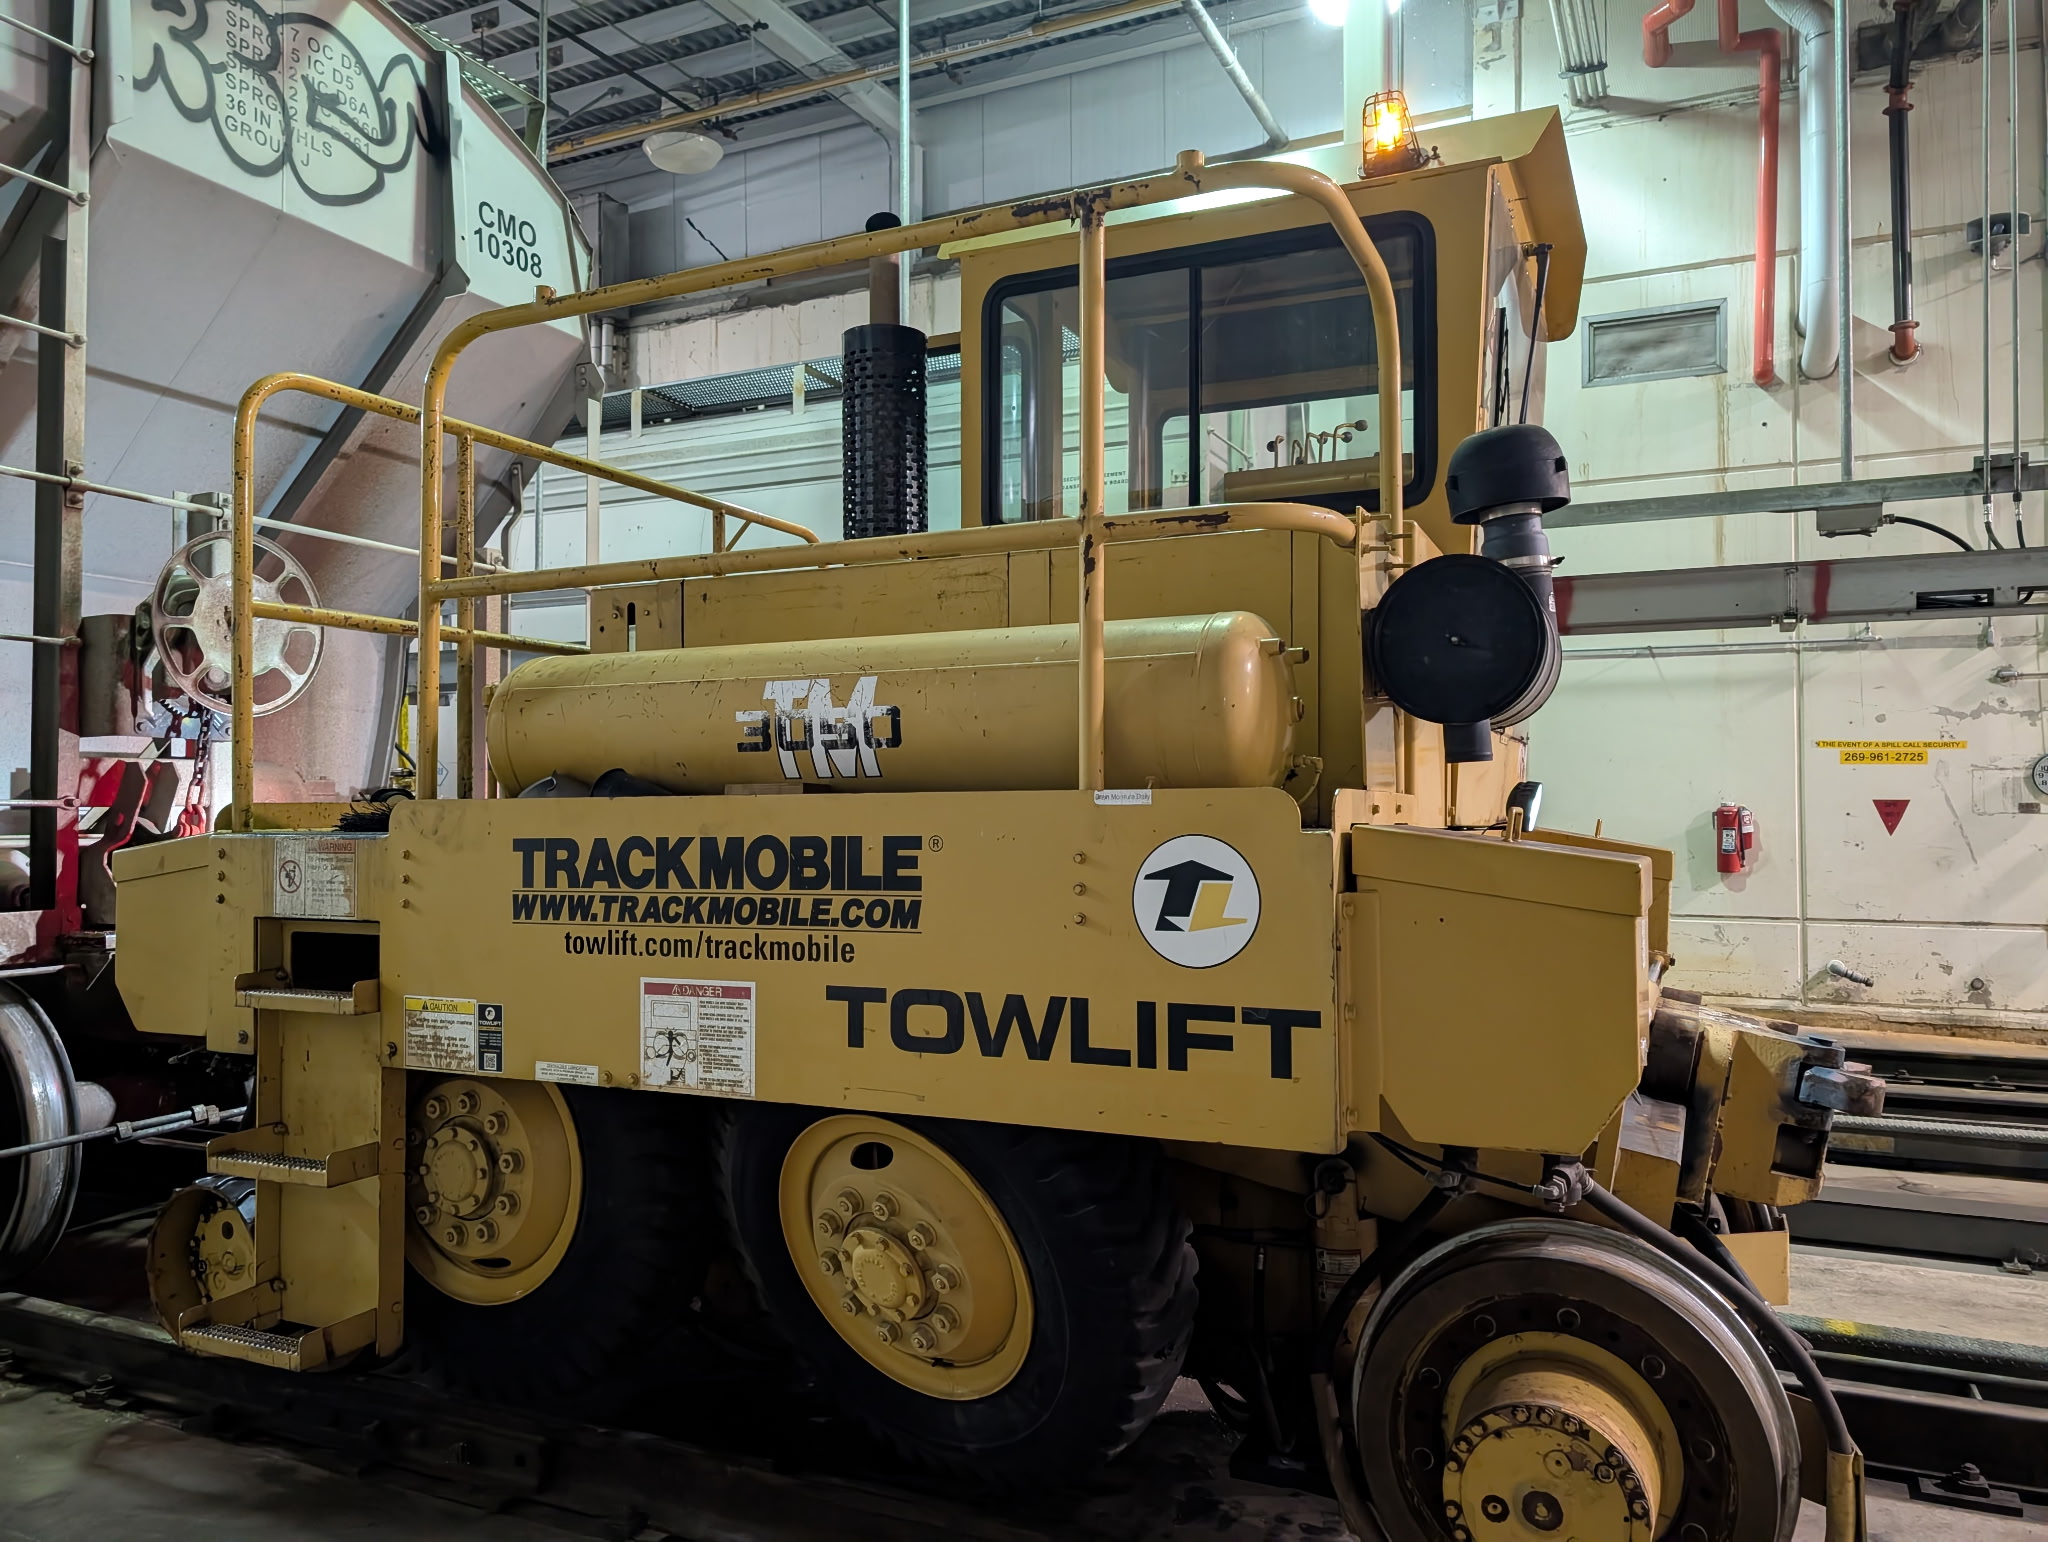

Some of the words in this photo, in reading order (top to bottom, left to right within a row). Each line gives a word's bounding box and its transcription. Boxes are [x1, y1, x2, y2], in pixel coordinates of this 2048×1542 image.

[290, 27, 300, 42] 7
[290, 48, 300, 63] 5
[333, 68, 354, 90] D5
[225, 73, 281, 114] SPRG.
[289, 106, 298, 122] 2
[225, 94, 246, 116] 36
[254, 107, 271, 129] IN
[289, 66, 298, 82] 2
[336, 88, 370, 119] D6A
[289, 86, 298, 102] 2
[225, 115, 281, 153] GROU
[301, 153, 309, 166] J
[479, 201, 536, 247] CMO
[474, 227, 542, 278] 10308
[763, 675, 883, 779] TM
[1843, 752, 1924, 762] 269-961-2725
[512, 835, 922, 891] TRACKMOBILE
[512, 894, 922, 929] WWW.TRACKMOBILE.COM
[564, 930, 855, 963] towlift.com/trackmobile
[429, 1003, 458, 1012] CAUTION
[682, 985, 722, 997] DANGER
[826, 985, 1322, 1080] TOWLIFT
